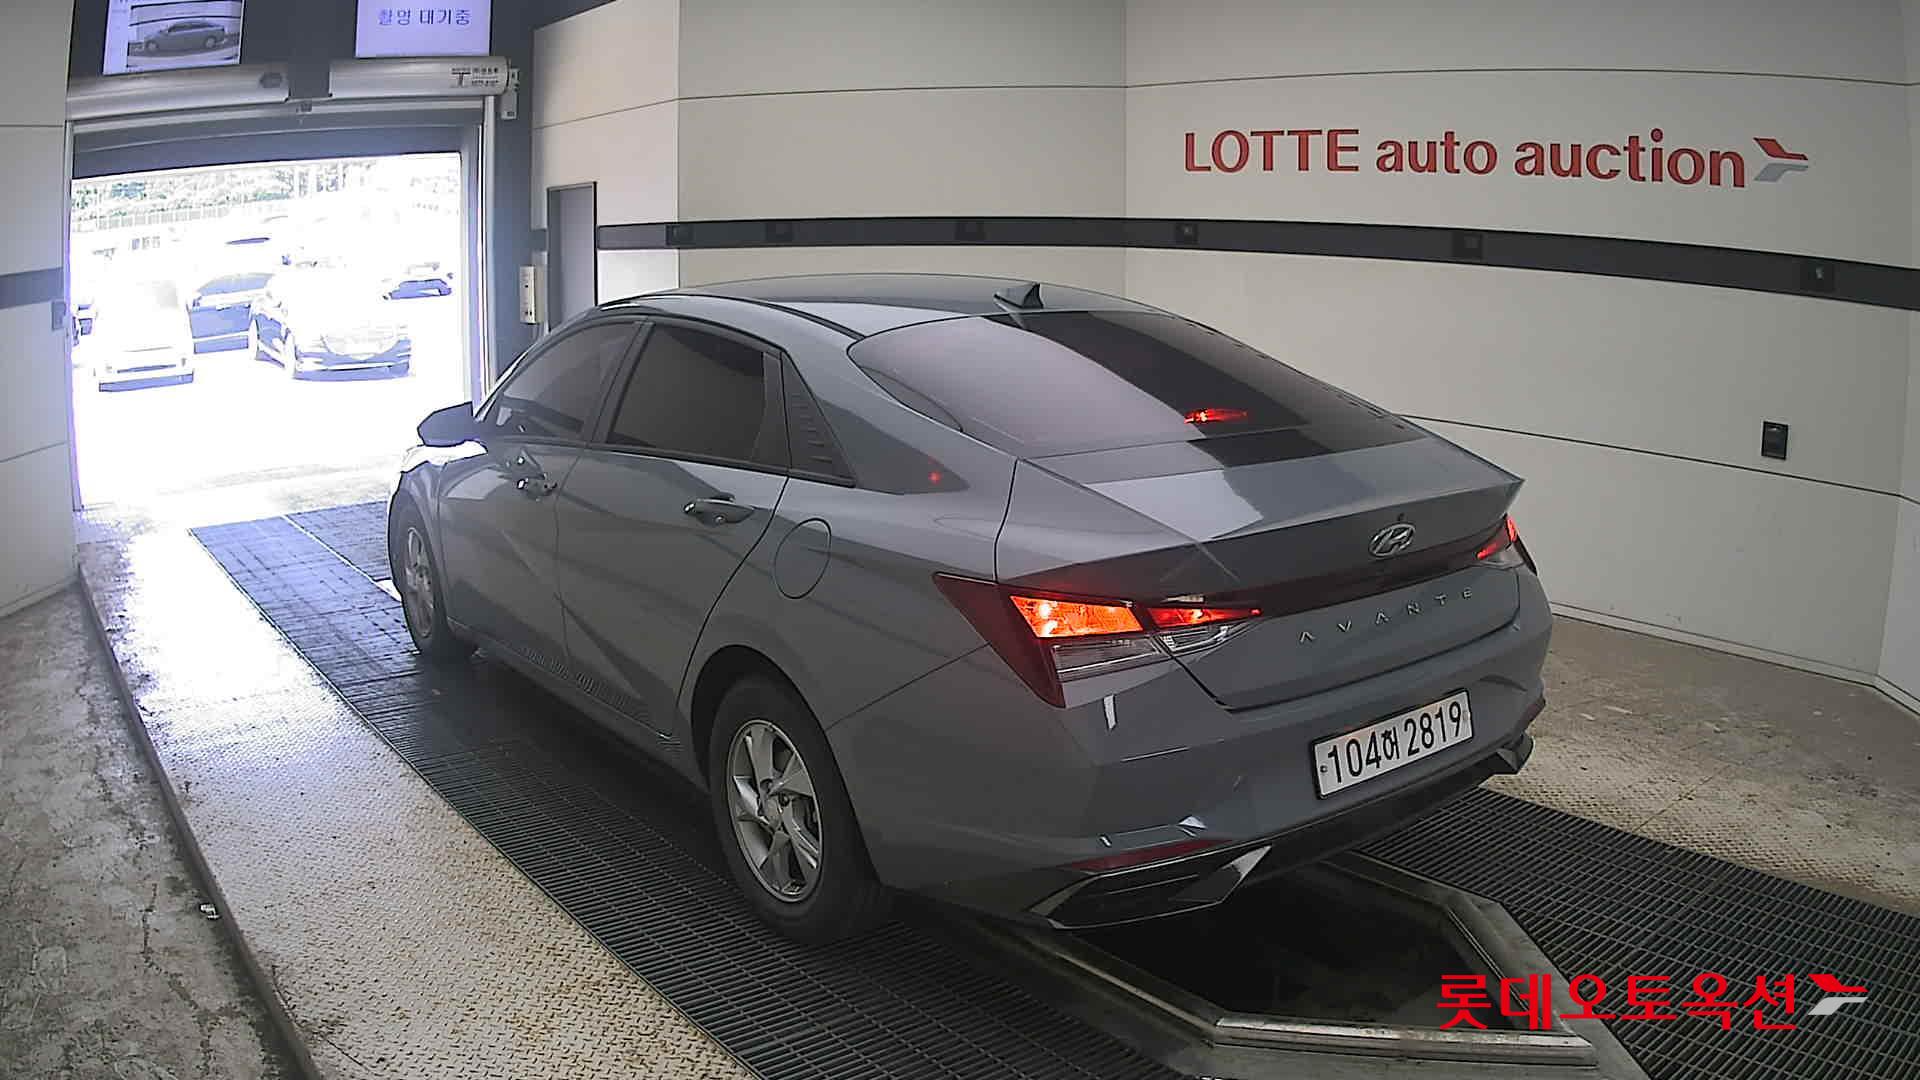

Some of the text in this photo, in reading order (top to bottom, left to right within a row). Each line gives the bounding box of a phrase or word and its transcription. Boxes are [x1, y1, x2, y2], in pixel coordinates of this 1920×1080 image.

[419, 9, 471, 26] 대기중
[1185, 128, 1747, 188] LOTTE auto auction
[1300, 587, 1473, 643] AVANTE
[1403, 701, 1462, 757] 2819
